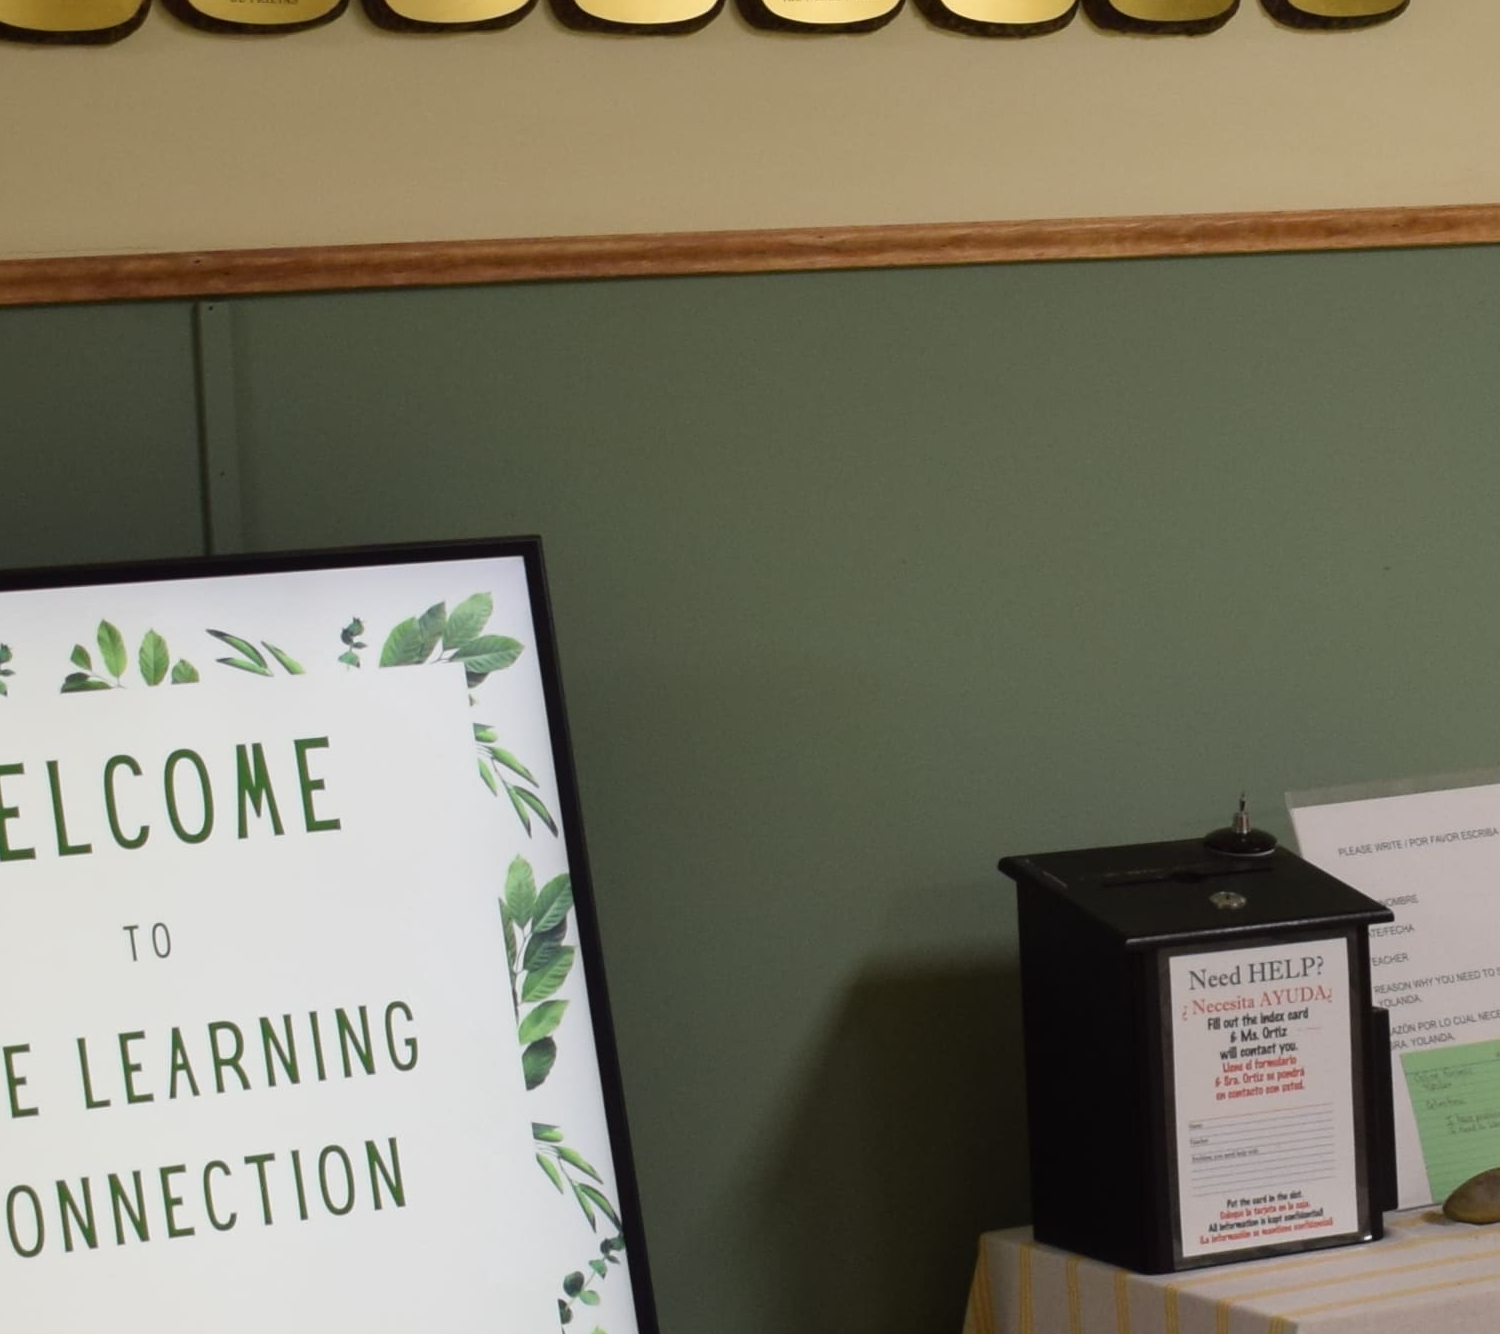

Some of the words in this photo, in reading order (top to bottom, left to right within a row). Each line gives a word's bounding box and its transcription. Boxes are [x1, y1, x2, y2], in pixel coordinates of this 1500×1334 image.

[1338, 844, 1373, 857] PLEASE
[1375, 840, 1403, 852] WRITE
[1410, 835, 1429, 847] POR
[1431, 831, 1460, 844] FAVOR
[1461, 827, 1500, 841] ESCRIBA
[123, 922, 171, 962] TO
[1372, 953, 1409, 966] EACHER
[1189, 965, 1241, 990] Need
[1248, 955, 1325, 984] HELP?
[1374, 981, 1412, 995] REASON
[1413, 977, 1435, 990] WHY
[1435, 974, 1455, 986] YOU
[1456, 970, 1481, 983] NEED
[1482, 967, 1495, 978] TO
[1192, 995, 1255, 1015] Necesita
[1208, 1018, 1221, 1030] Fill
[1224, 1017, 1239, 1028] out
[1242, 1014, 1258, 1026] the
[1260, 1011, 1285, 1024] index
[1288, 1007, 1309, 1020] card
[1390, 1022, 1417, 1037] AZÓN
[1417, 1021, 1436, 1033] POR
[1438, 1018, 1452, 1030] LO
[1453, 1014, 1477, 1026] CUAL
[1241, 1029, 1259, 1042] Ms.
[1262, 1026, 1288, 1038] Ortiz
[76, 1000, 419, 1110] LEARNING
[1220, 1046, 1237, 1060] will
[1240, 1043, 1276, 1058] contact
[1279, 1042, 1298, 1055] you.
